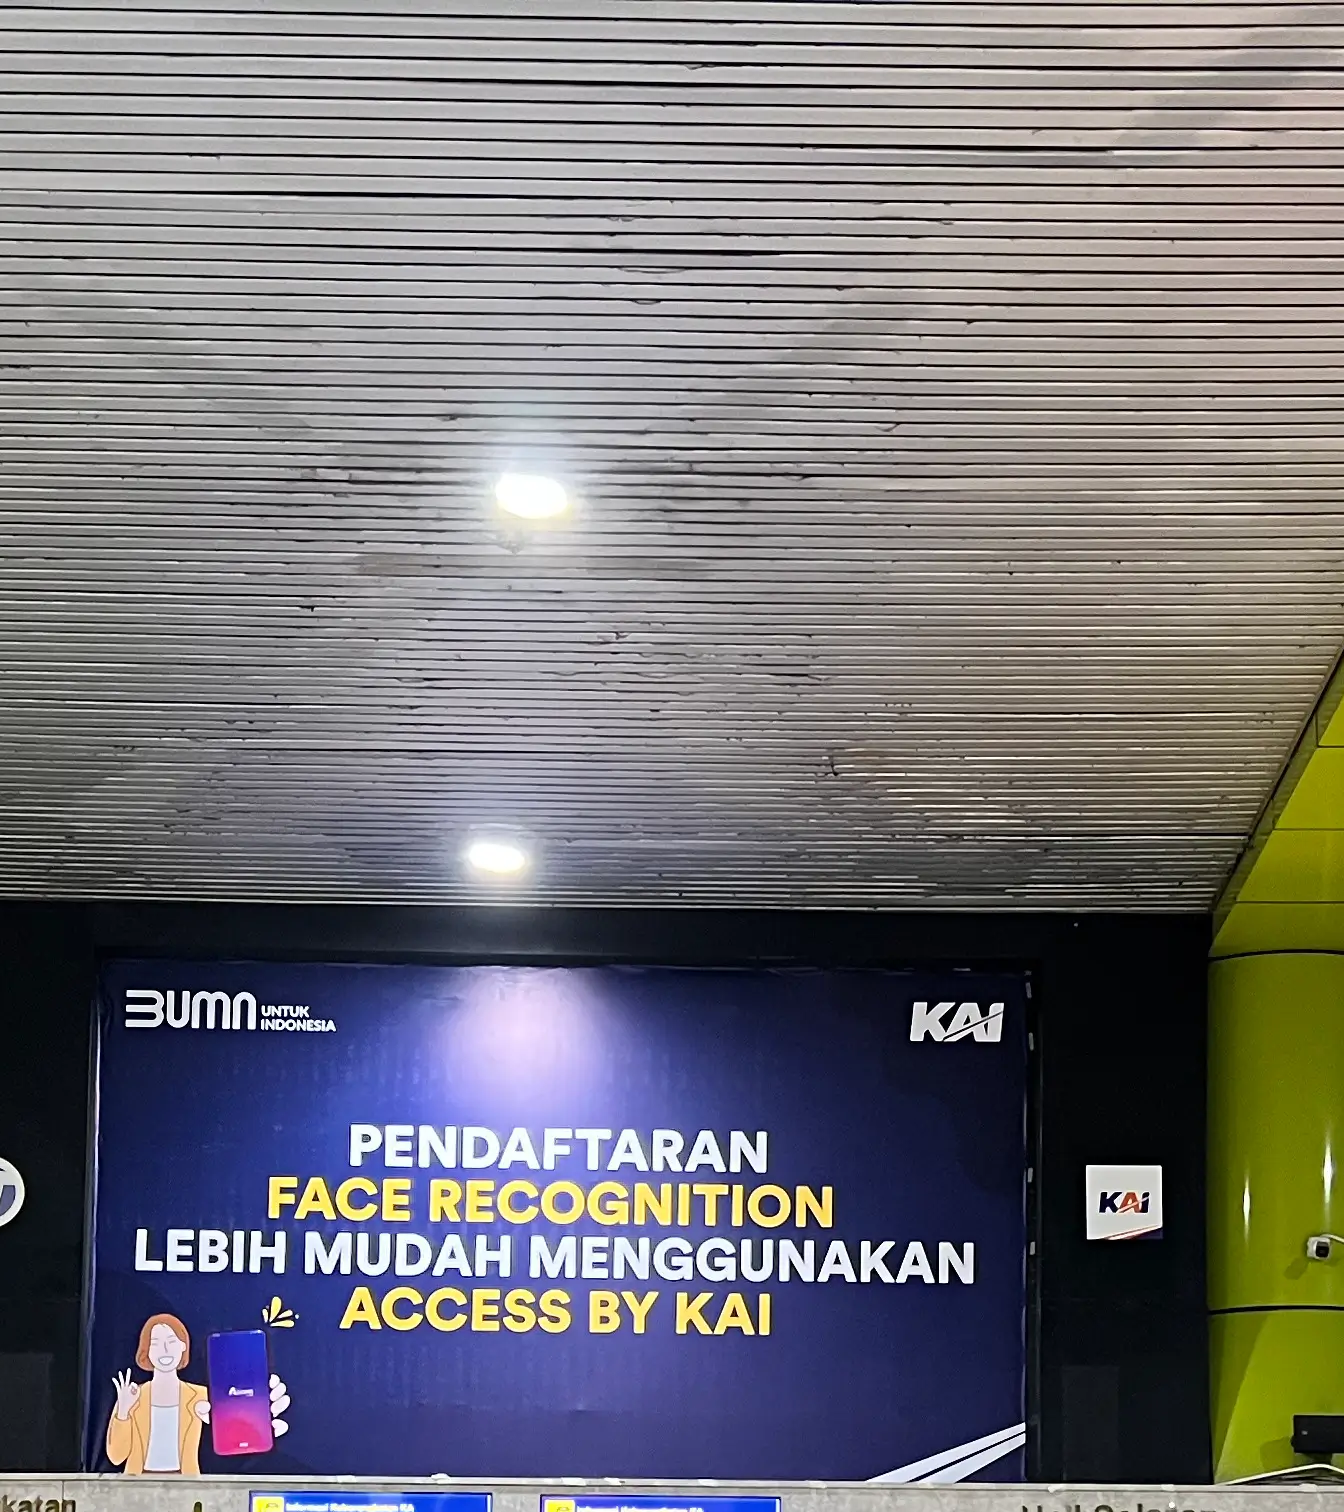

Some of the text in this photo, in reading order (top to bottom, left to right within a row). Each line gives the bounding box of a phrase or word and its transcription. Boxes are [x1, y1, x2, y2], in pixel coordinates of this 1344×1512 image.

[260, 1005, 310, 1018] UNTUK
[260, 1018, 337, 1032] INDONESIA
[909, 1002, 1004, 1042] KAI
[348, 1123, 769, 1174] PENDAFTARAN
[267, 1176, 833, 1228] FACE RECOGNITION
[1098, 1191, 1150, 1213] KAI
[134, 1228, 975, 1285] LEBIH MUDAH MENGGUNAKAN
[339, 1286, 771, 1336] ACCESS BY KAI
